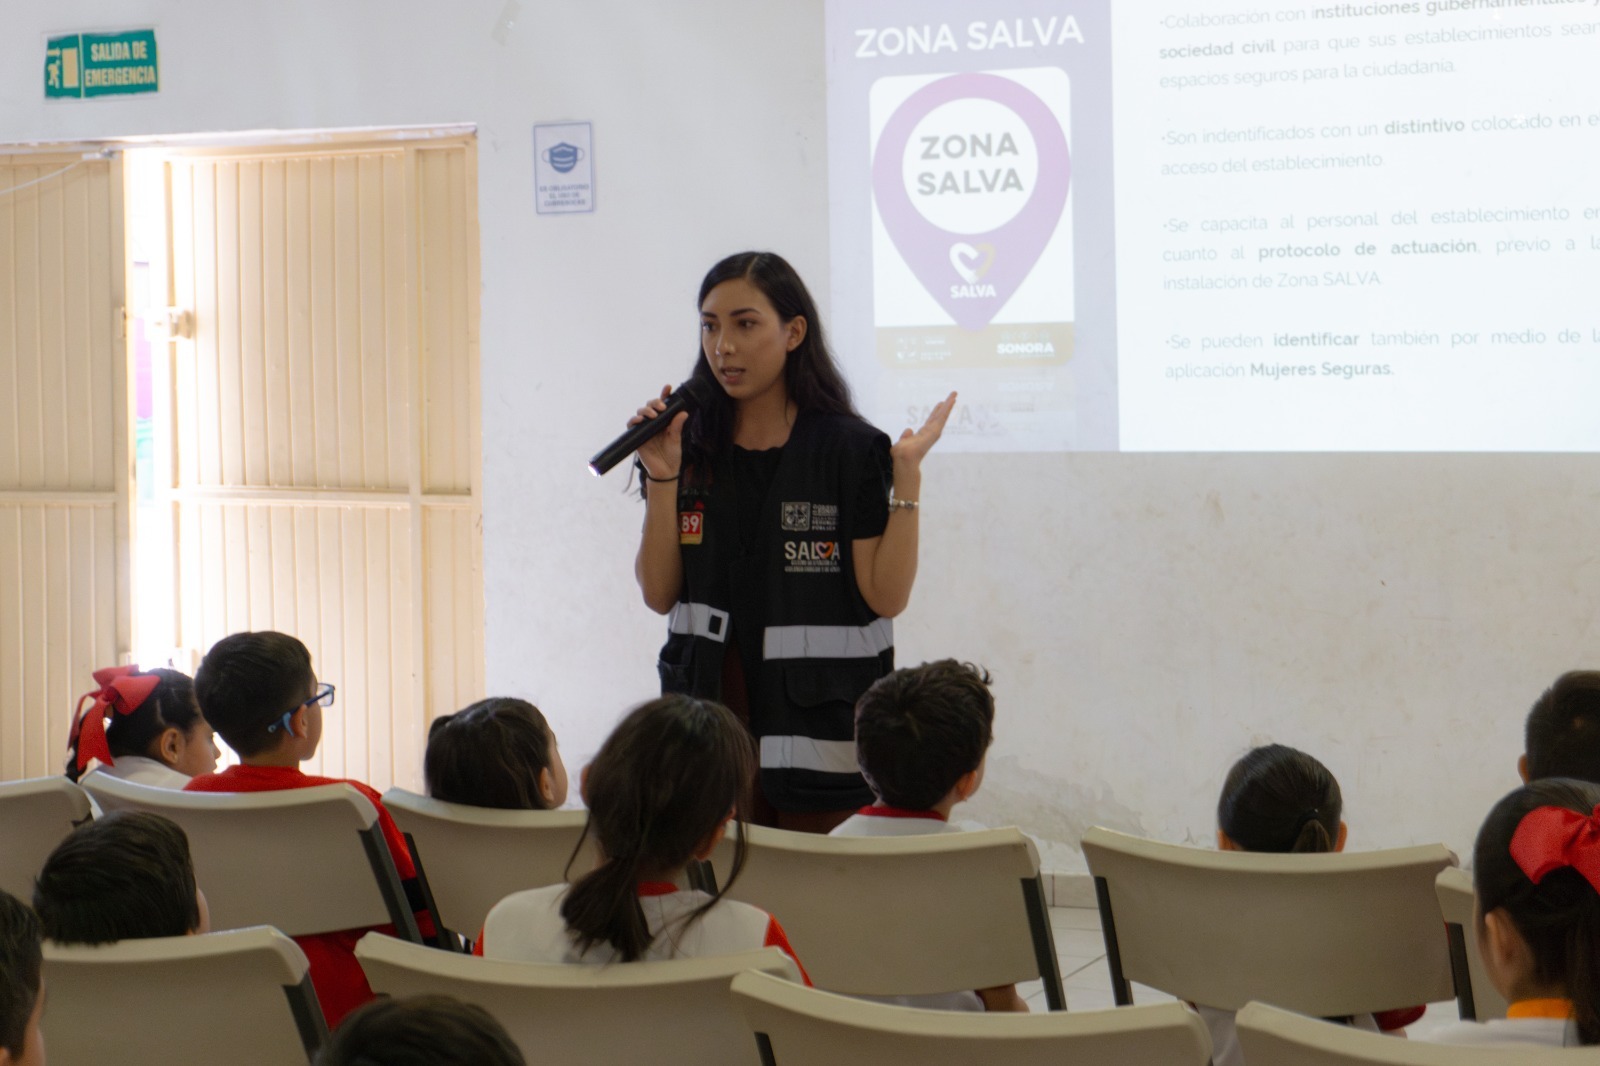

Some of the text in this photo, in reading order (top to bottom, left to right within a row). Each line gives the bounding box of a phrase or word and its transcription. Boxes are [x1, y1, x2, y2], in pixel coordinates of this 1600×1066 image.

[1275, 10, 1306, 22] con
[855, 15, 1084, 57] ZONA SALVA
[1159, 41, 1234, 59] sociedad
[1241, 39, 1276, 54] civil
[1283, 39, 1319, 55] para
[1328, 36, 1360, 52] que
[1368, 34, 1397, 47] sus
[1405, 24, 1552, 45] establecimientos
[91, 41, 147, 62] SALIDA DE
[85, 66, 156, 87] EMERGENCIA
[1159, 71, 1229, 91] espacios
[1234, 69, 1298, 87] seguros
[1303, 67, 1339, 84] para
[1344, 63, 1358, 78] la
[1202, 124, 1315, 143] indentificados
[1320, 125, 1351, 138] con
[1358, 124, 1378, 136] un
[1384, 118, 1465, 135] distintivo
[1471, 113, 1552, 132] colocado
[1558, 115, 1581, 128] en
[920, 132, 1019, 160] ZONA
[1161, 161, 1218, 175] acceso
[1222, 158, 1248, 173] del
[917, 168, 1024, 196] SALVA
[1201, 216, 1268, 234] capacita
[1280, 214, 1294, 229] al
[1307, 211, 1379, 232] personal
[1391, 211, 1417, 225] del
[1431, 206, 1570, 224] establecimiento
[1163, 247, 1218, 262] cuanto
[1230, 245, 1245, 260] al
[1258, 243, 1341, 263] protocolo
[1354, 241, 1377, 256] de
[1496, 236, 1551, 256] previo
[1565, 238, 1575, 251] a
[950, 284, 997, 299] SALVA
[1163, 275, 1248, 290] instalación
[1252, 274, 1273, 288] de
[1277, 273, 1319, 288] Zona
[996, 342, 1055, 355] SONORA
[1201, 333, 1263, 351] pueden
[1273, 332, 1360, 347] identificar
[1371, 330, 1439, 345] también
[1451, 332, 1480, 348] por
[1491, 329, 1546, 344] medio
[1557, 328, 1581, 344] de
[1165, 361, 1395, 381] aplicación Mujeres Seguras.
